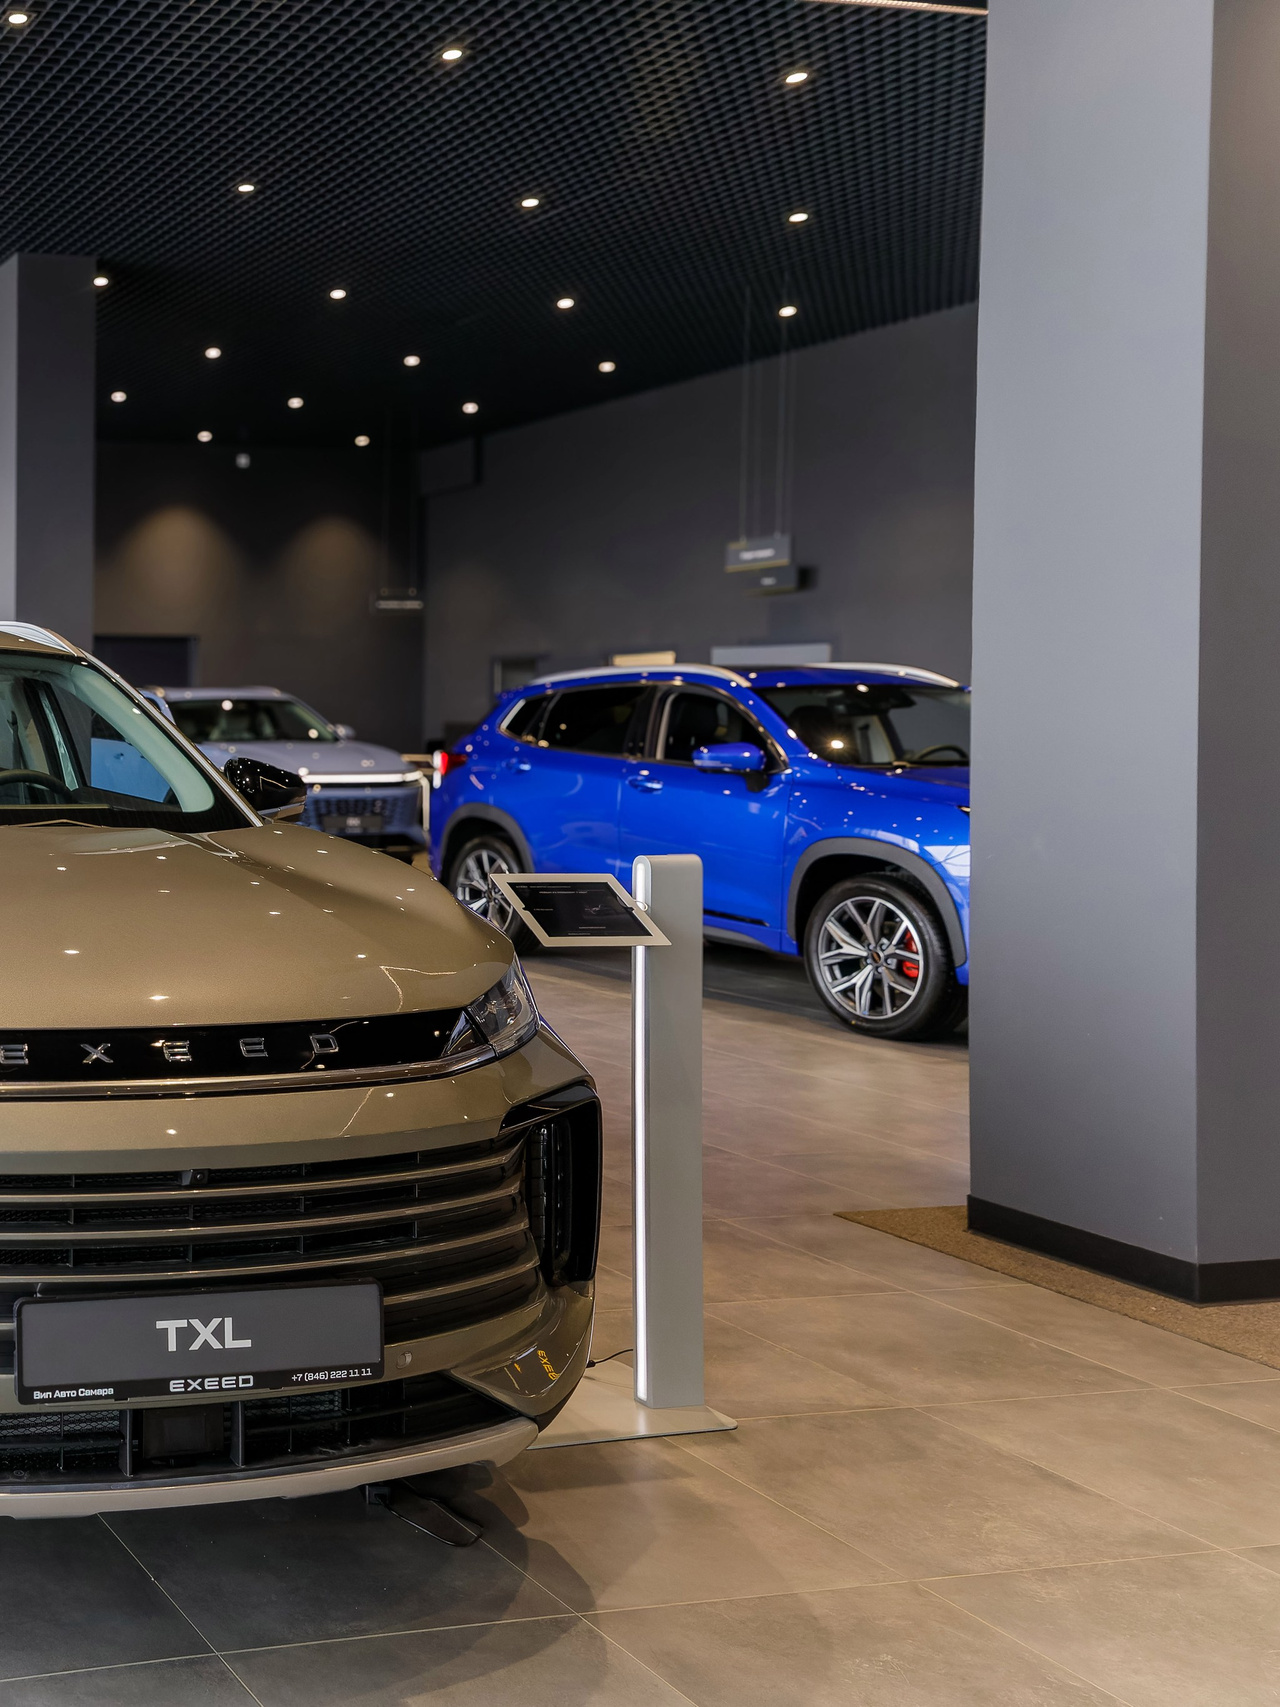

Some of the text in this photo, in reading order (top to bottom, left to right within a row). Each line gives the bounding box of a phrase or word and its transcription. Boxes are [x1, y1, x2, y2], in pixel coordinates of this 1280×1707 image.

[156, 1317, 252, 1352] TXL
[304, 1371, 328, 1381] (846)
[330, 1370, 347, 1379] 222
[349, 1369, 360, 1377] 11
[361, 1368, 372, 1376] 11
[170, 1375, 254, 1392] EXEED
[33, 1388, 114, 1399] Вип Авто Самара
